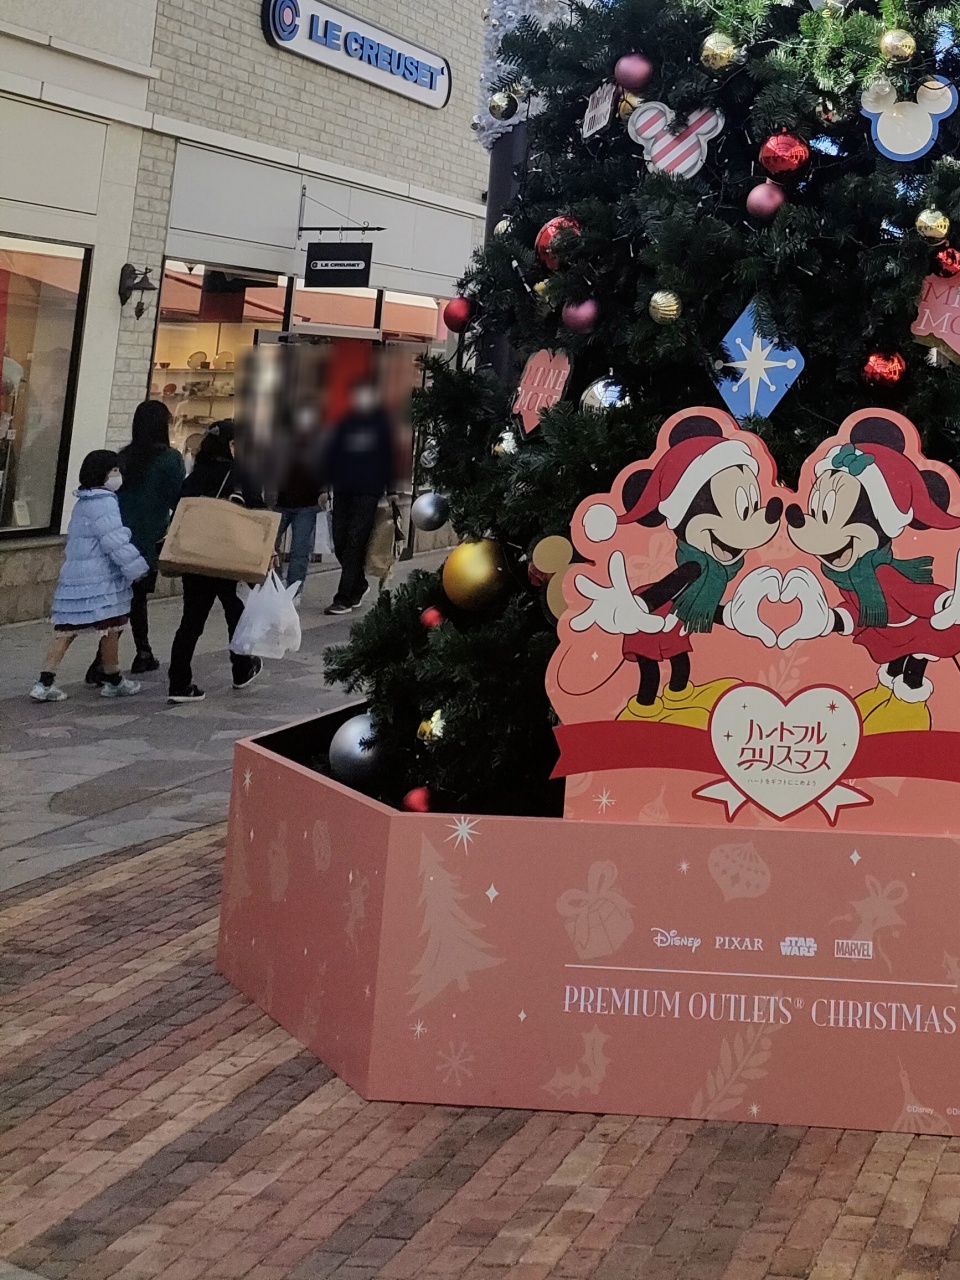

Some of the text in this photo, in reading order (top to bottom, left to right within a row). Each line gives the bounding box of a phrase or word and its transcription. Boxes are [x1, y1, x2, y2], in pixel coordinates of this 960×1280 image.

[308, 13, 443, 91] LE CREUSET
[745, 719, 827, 745] ハートフル
[737, 745, 831, 773] クリスマス
[715, 936, 764, 951] PIXAR
[780, 936, 817, 947] STAR
[780, 946, 817, 956] WARS
[835, 940, 872, 958] MARVEL
[563, 984, 681, 1019] PREMIUM
[811, 998, 958, 1035] CHRISTMAS
